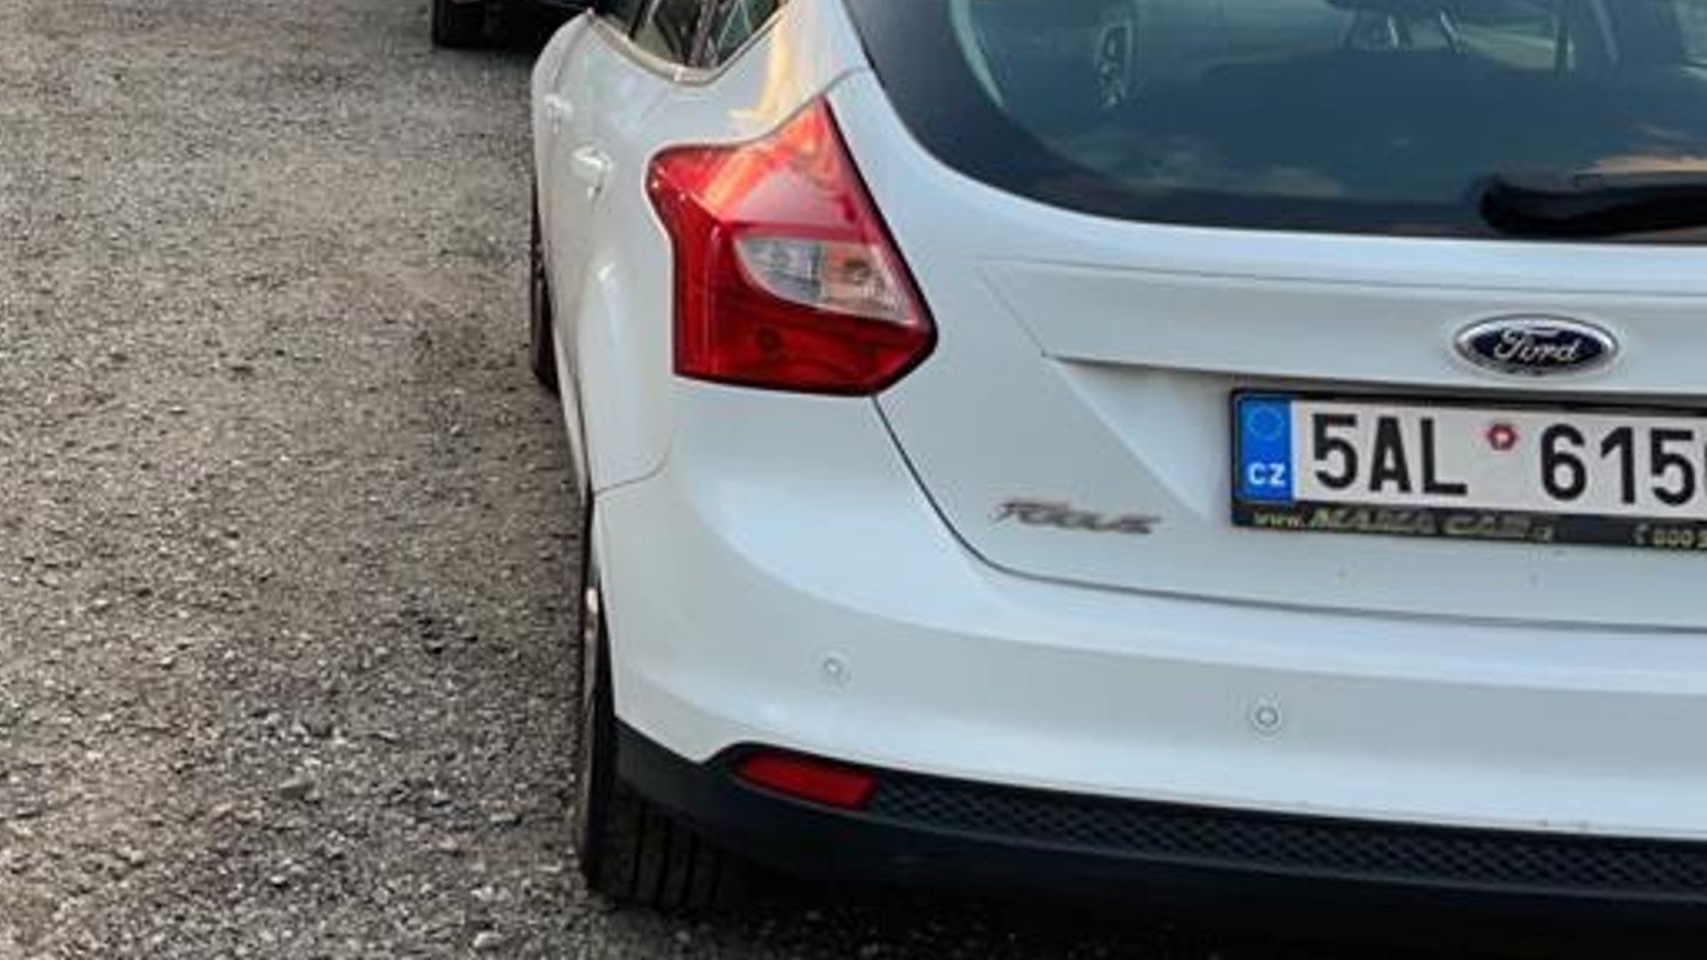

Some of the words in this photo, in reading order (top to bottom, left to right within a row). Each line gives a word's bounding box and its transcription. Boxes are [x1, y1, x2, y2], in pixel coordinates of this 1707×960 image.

[1495, 328, 1580, 363] Ford
[1247, 462, 1286, 487] CZ
[1312, 412, 1469, 496] 5AL
[1540, 422, 1707, 507] 615
